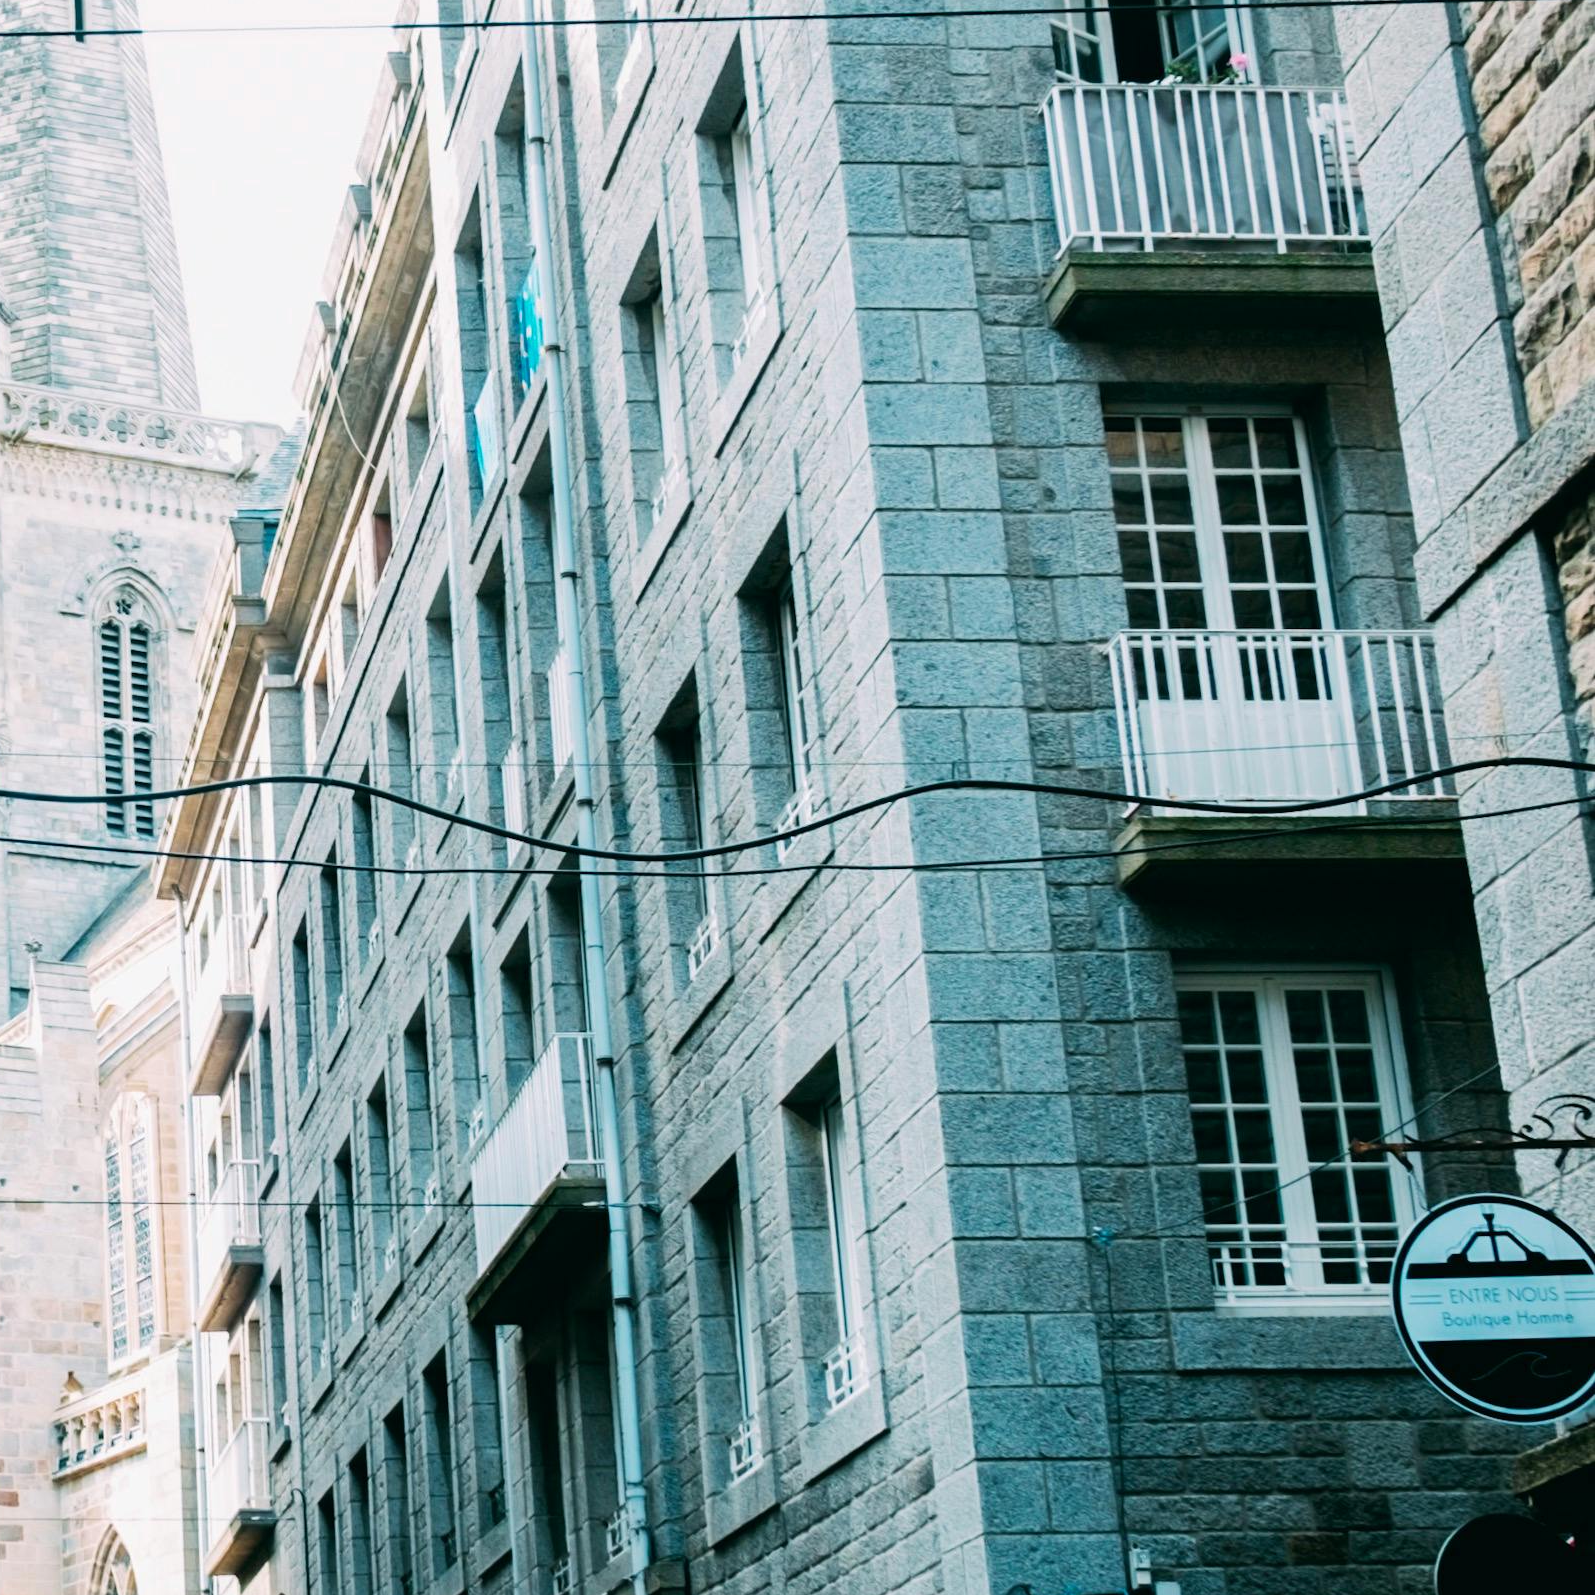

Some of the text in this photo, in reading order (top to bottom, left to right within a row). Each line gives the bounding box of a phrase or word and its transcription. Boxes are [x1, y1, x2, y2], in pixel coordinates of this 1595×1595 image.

[1449, 1286, 1559, 1304] ENTRE NOUS
[1441, 1310, 1575, 1328] Boutique Homme
